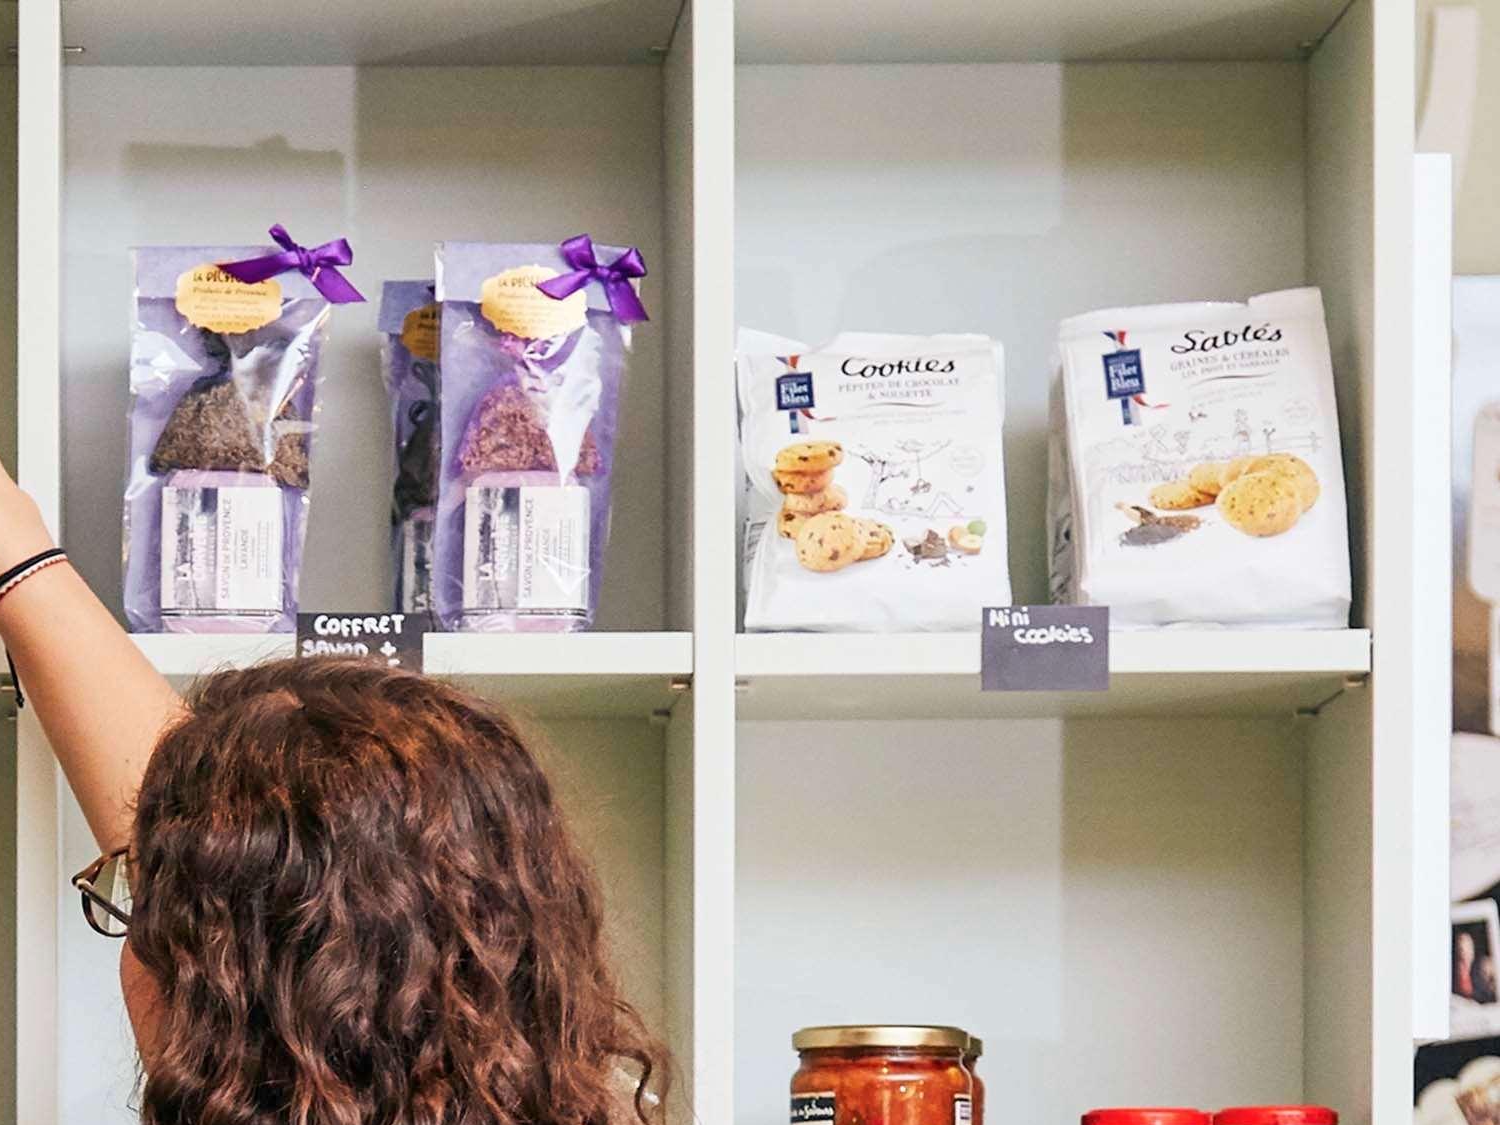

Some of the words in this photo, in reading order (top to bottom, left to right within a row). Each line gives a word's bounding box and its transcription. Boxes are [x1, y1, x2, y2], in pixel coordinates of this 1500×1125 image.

[1170, 321, 1283, 355] Sablés
[840, 356, 956, 379] Cookies
[1108, 363, 1139, 377] Filet
[780, 382, 809, 396] Filet
[221, 497, 232, 552] PROVENCE
[523, 497, 534, 551] PROVENCE
[313, 613, 406, 638] COFFRET
